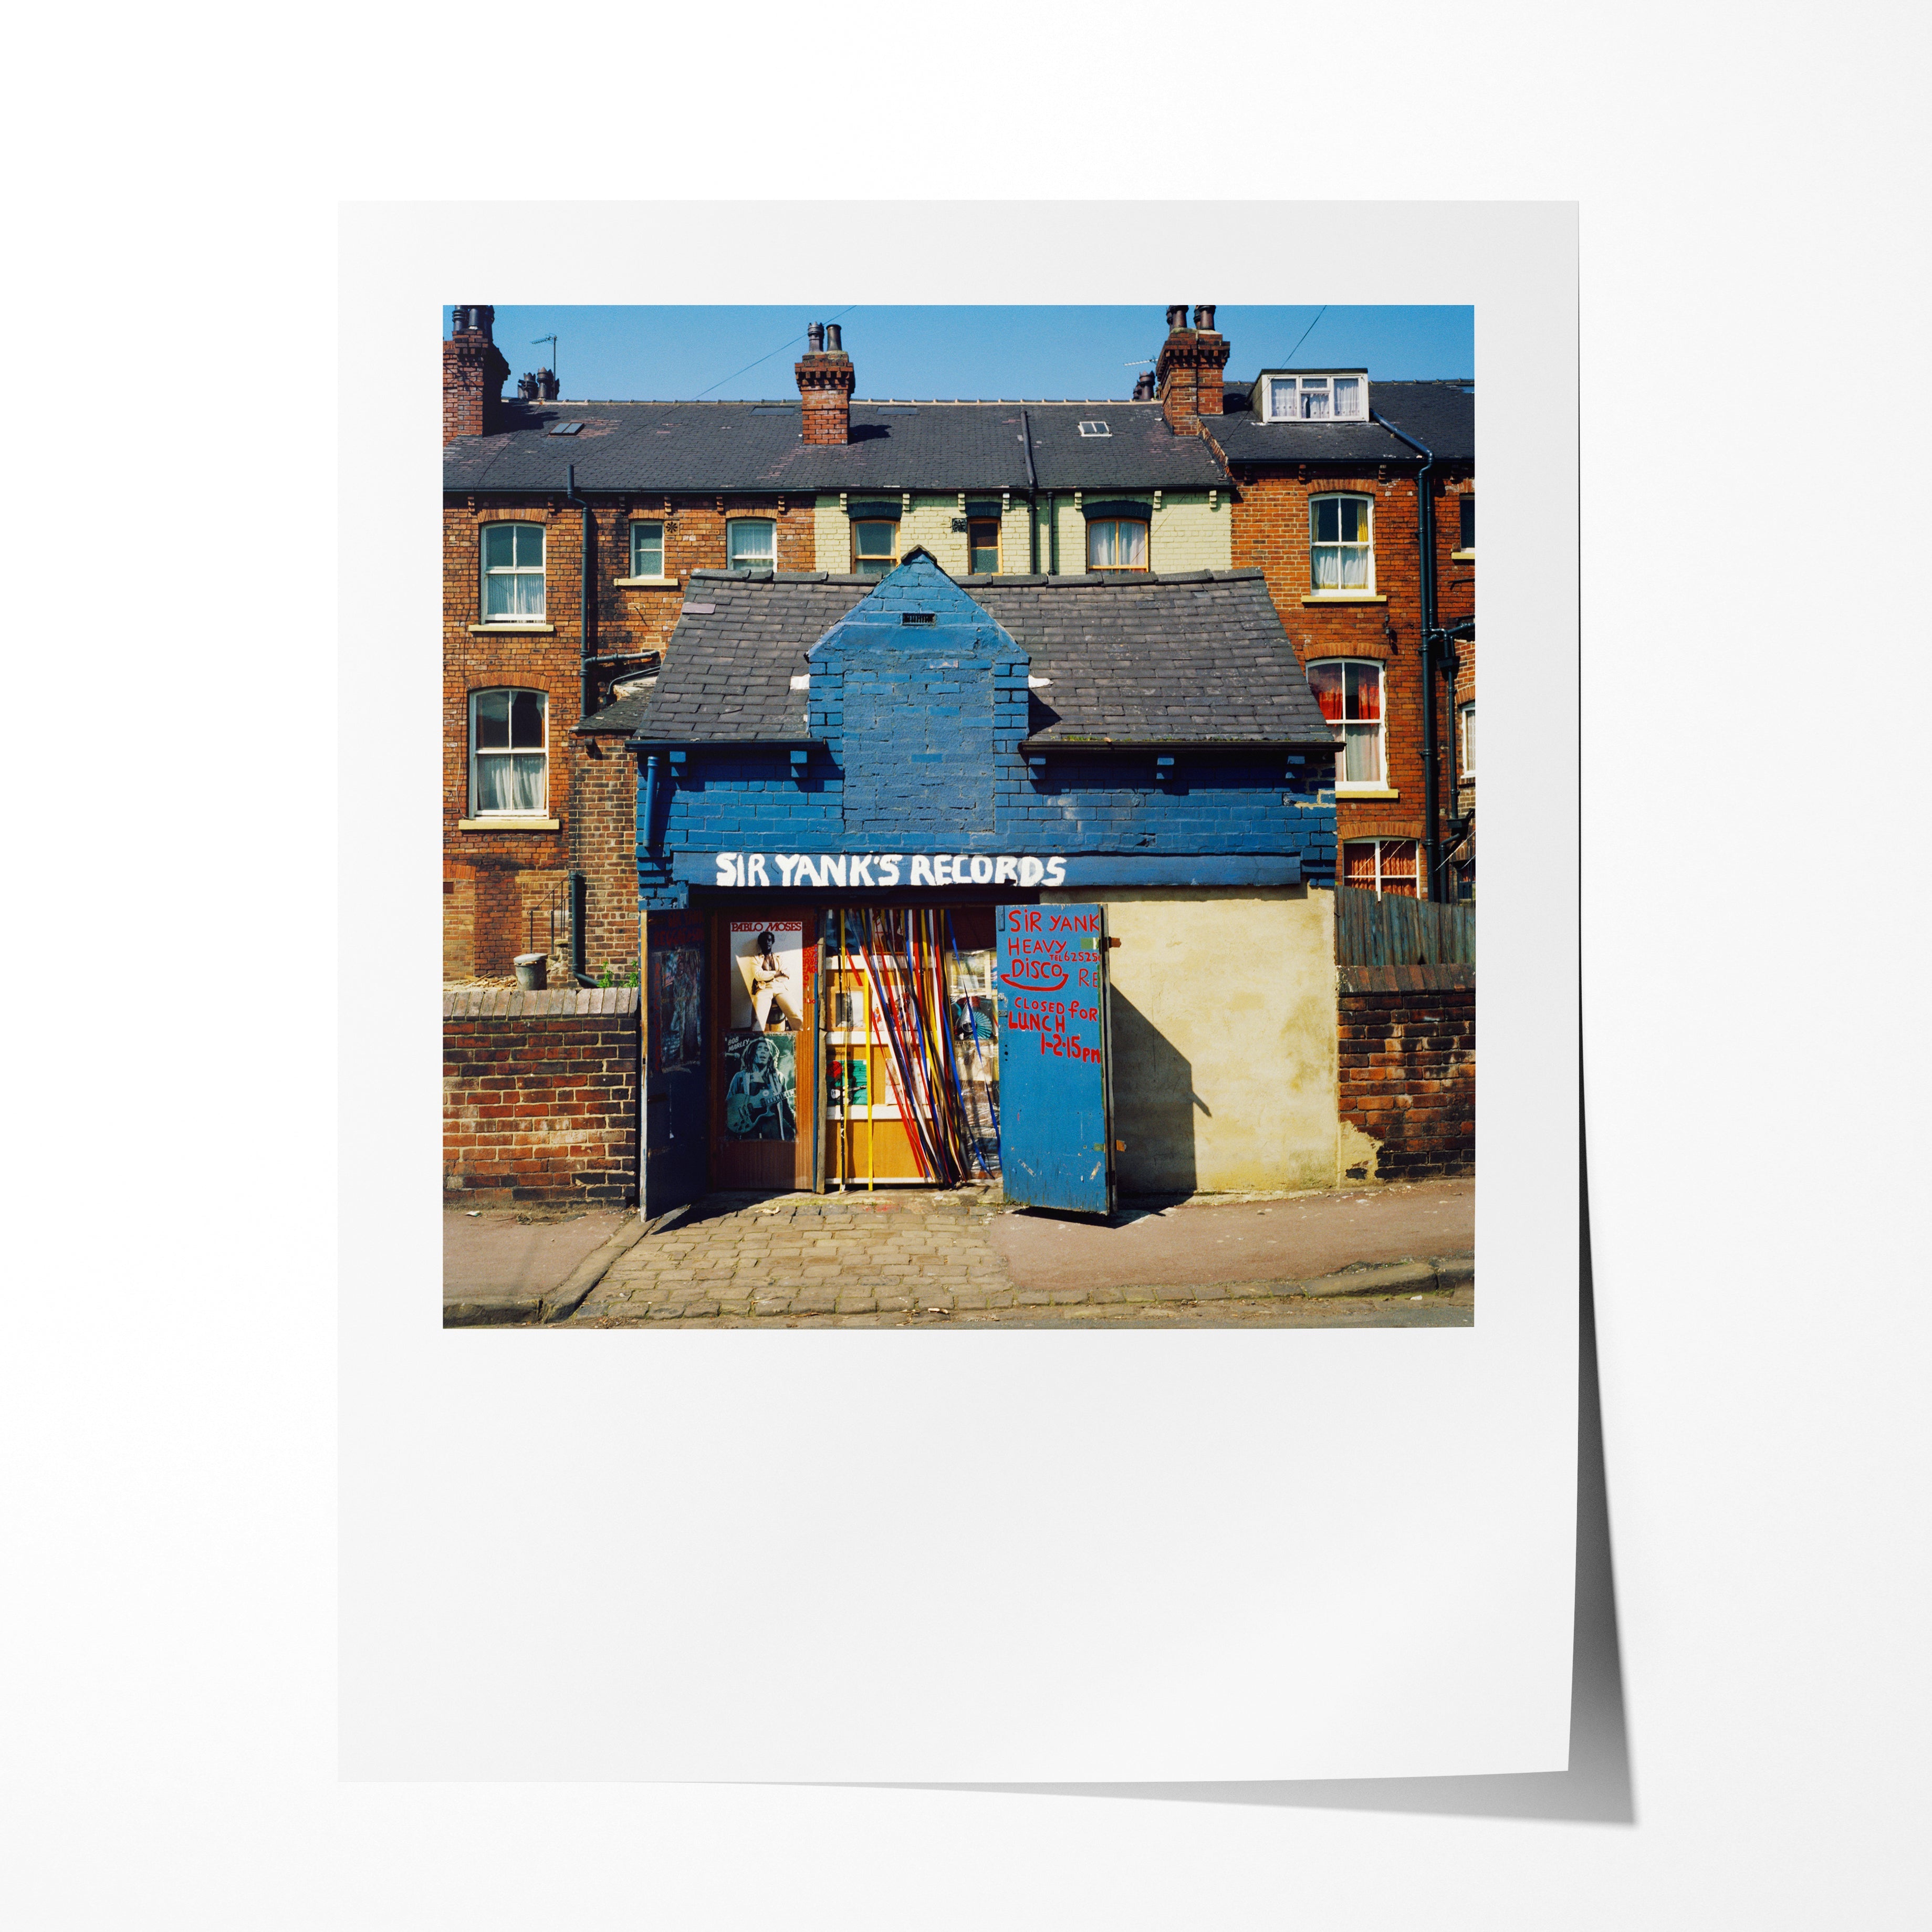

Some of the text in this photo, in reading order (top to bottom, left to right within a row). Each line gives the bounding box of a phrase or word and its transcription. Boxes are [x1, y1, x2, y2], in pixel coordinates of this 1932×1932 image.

[716, 852, 1067, 887] SIR YANK'S RECORDS
[731, 922, 802, 932] PABLO MOSES
[1008, 937, 1067, 956] HEAVY
[1014, 997, 1065, 1015] CLOSED
[1008, 1011, 1066, 1033] LUNCH
[728, 1036, 739, 1046] BOB
[728, 1038, 750, 1052] MARLEY
